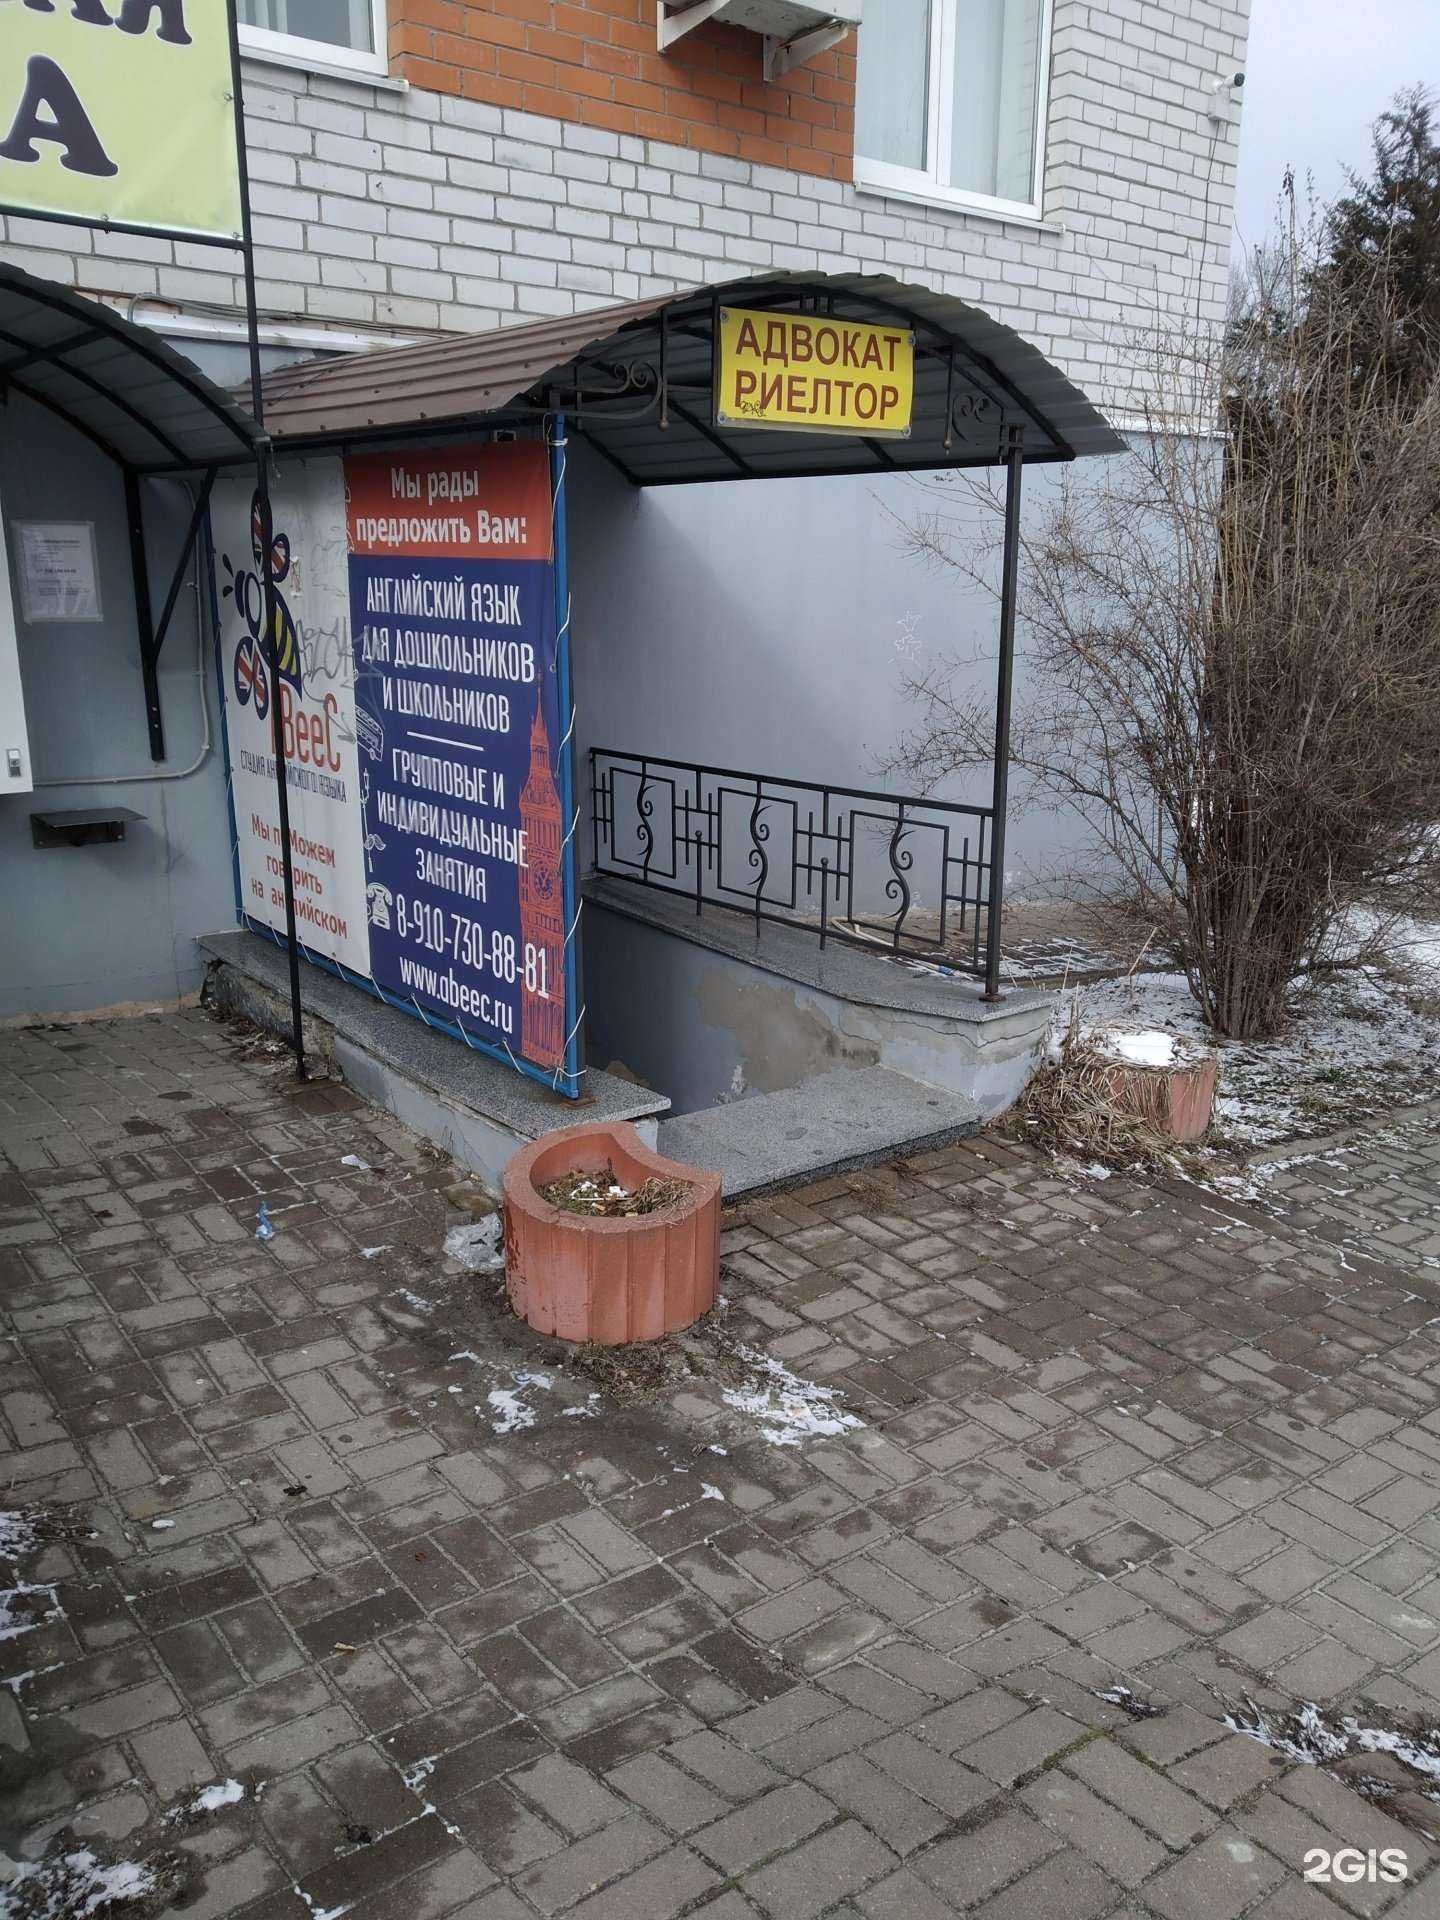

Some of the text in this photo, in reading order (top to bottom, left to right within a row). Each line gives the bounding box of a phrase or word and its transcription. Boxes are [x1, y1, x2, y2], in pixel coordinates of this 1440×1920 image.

[736, 318, 901, 372] АДВОКАТ
[735, 369, 899, 420] РИЕЛТОР
[391, 467, 479, 505] Мы рады
[356, 509, 527, 549] предложить Вам:
[366, 573, 522, 627] АНГЛИЙСКИЙ ЯЗЫК
[361, 624, 390, 664] ДЛЯ
[394, 628, 536, 684] ДОШКОЛЬНИКОВ
[382, 676, 511, 734] И ШКОЛЬНИКОВ
[391, 747, 506, 811] ГРУППОВЫЕ И
[251, 813, 271, 842] Мы
[376, 790, 530, 869] ИНДИВИДУАЛЬНЫЕ
[266, 855, 323, 895] говрить
[415, 847, 488, 904] ЗАНЯТИЯ
[251, 877, 347, 940] на анлийском
[395, 893, 551, 1000] 8-910-730-88-81
[400, 955, 514, 1035] www.abeec.ru
